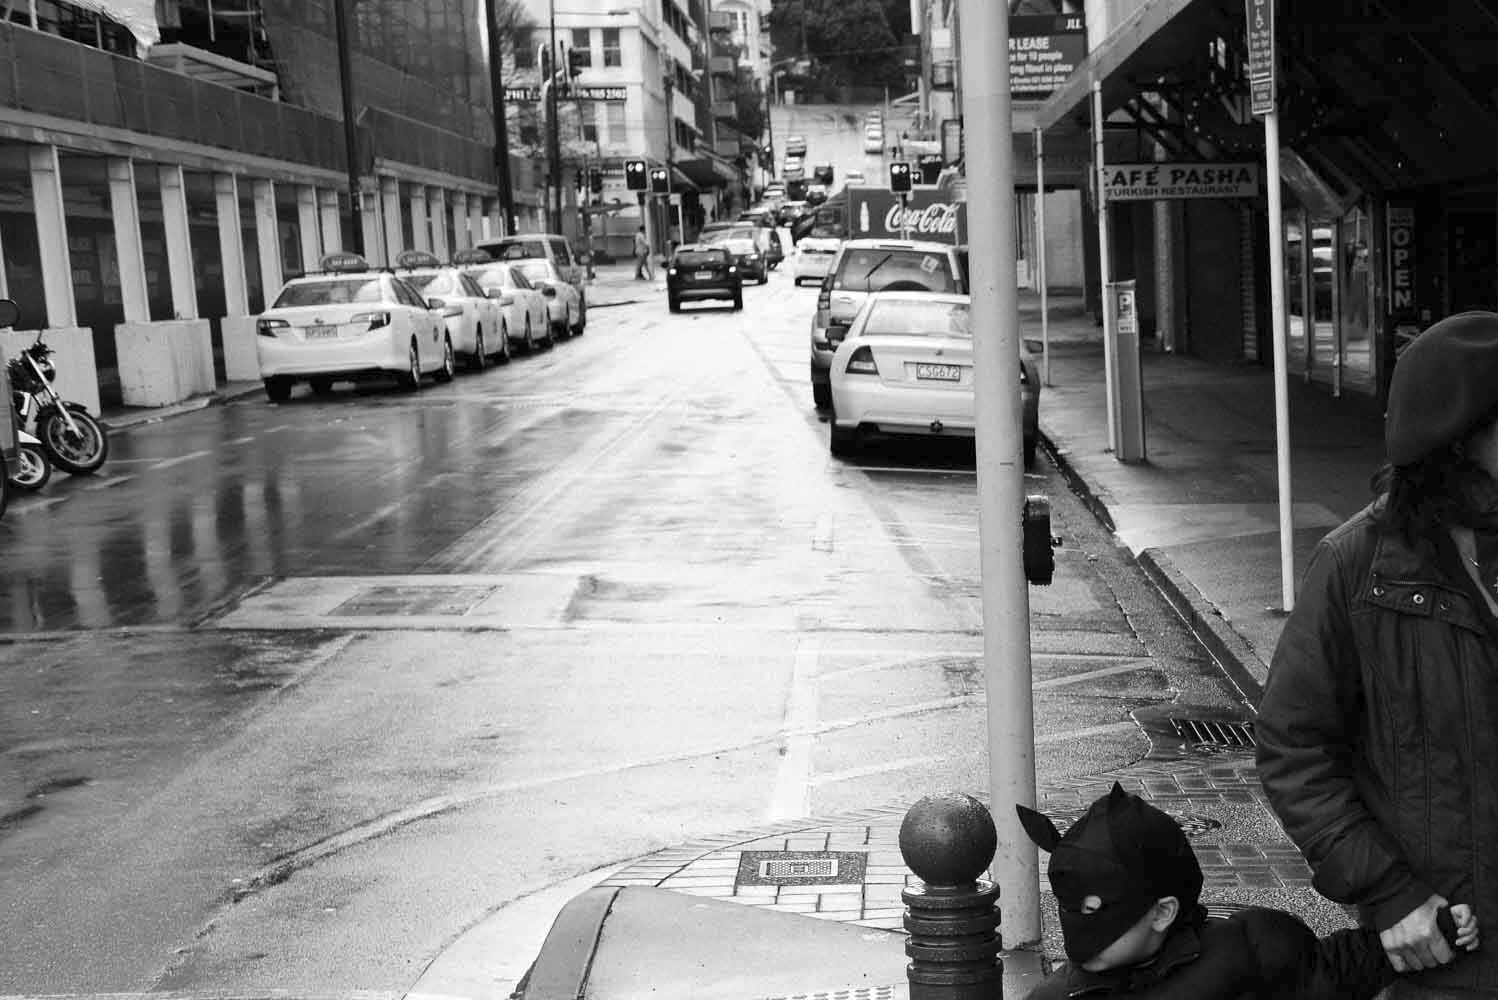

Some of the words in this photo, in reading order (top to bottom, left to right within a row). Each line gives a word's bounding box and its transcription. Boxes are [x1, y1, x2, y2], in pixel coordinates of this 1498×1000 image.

[1017, 37, 1050, 50] LEASE
[1170, 167, 1251, 186] PASHA
[1392, 228, 1412, 309] OPEN
